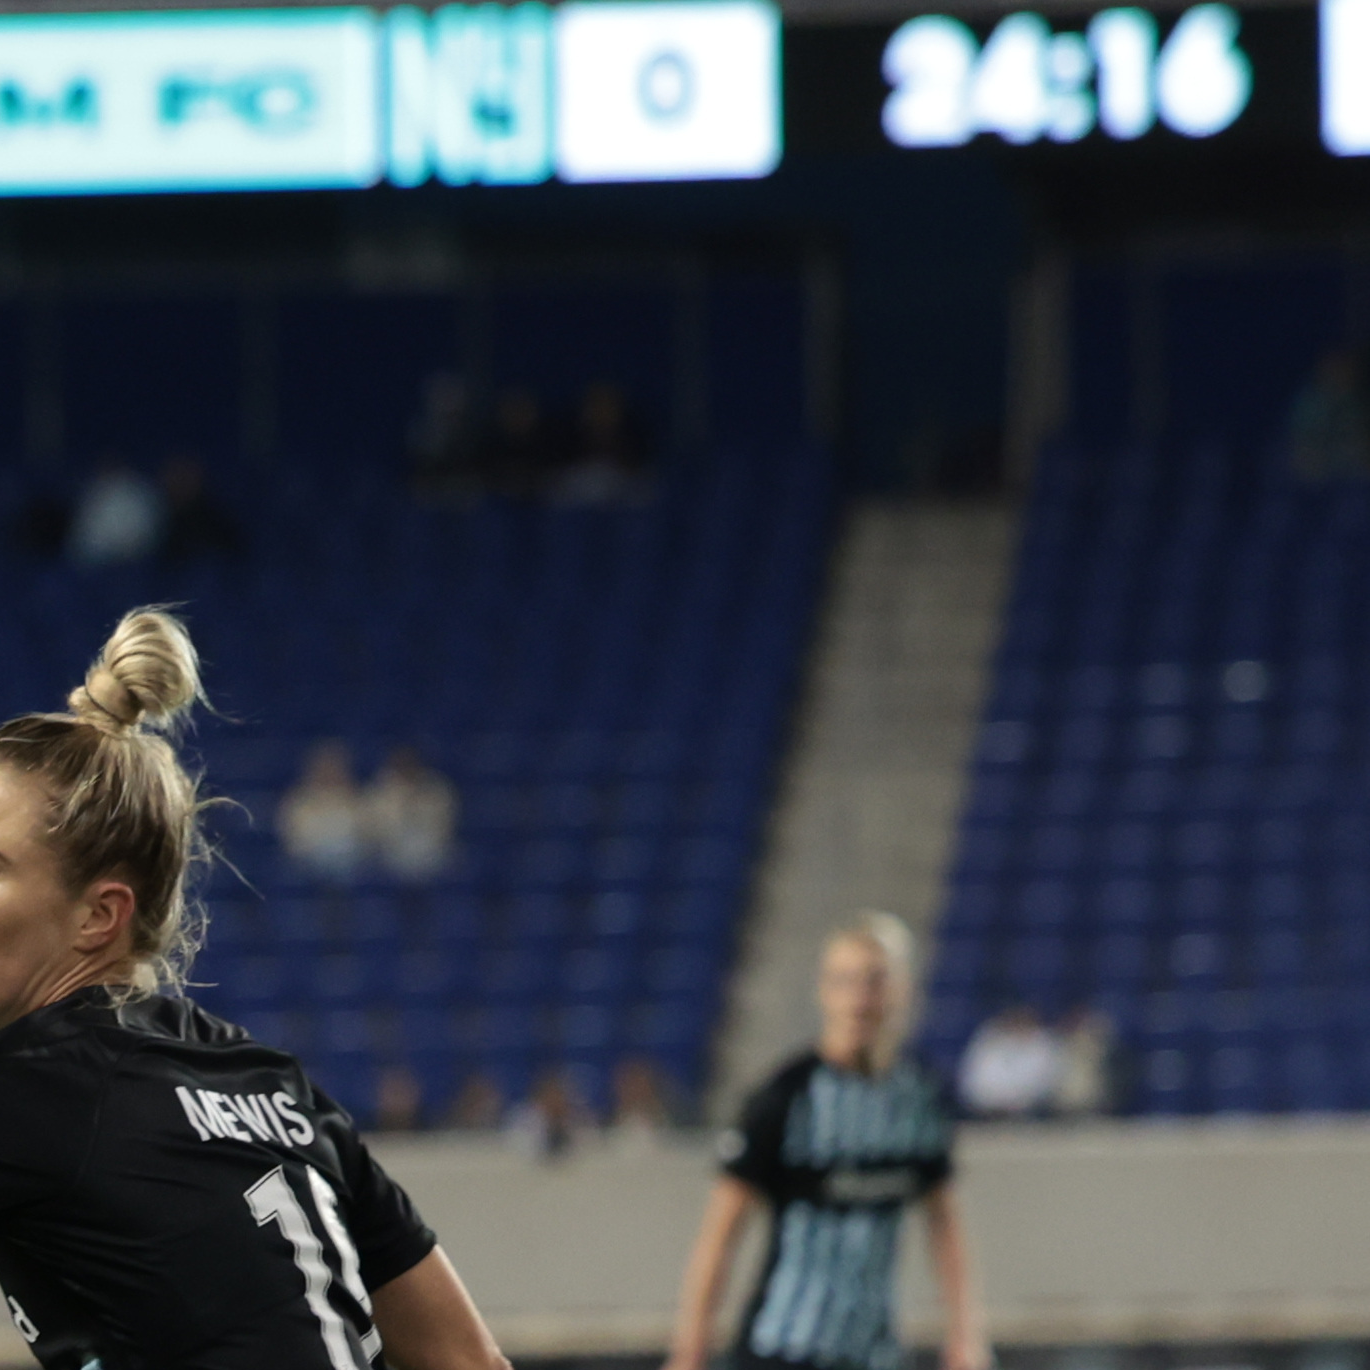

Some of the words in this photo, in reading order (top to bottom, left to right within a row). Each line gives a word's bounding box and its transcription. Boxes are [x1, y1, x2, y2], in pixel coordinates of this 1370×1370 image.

[635, 43, 699, 129] 0
[880, 4, 1254, 148] 24:16
[175, 1085, 315, 1148] MEWIS
